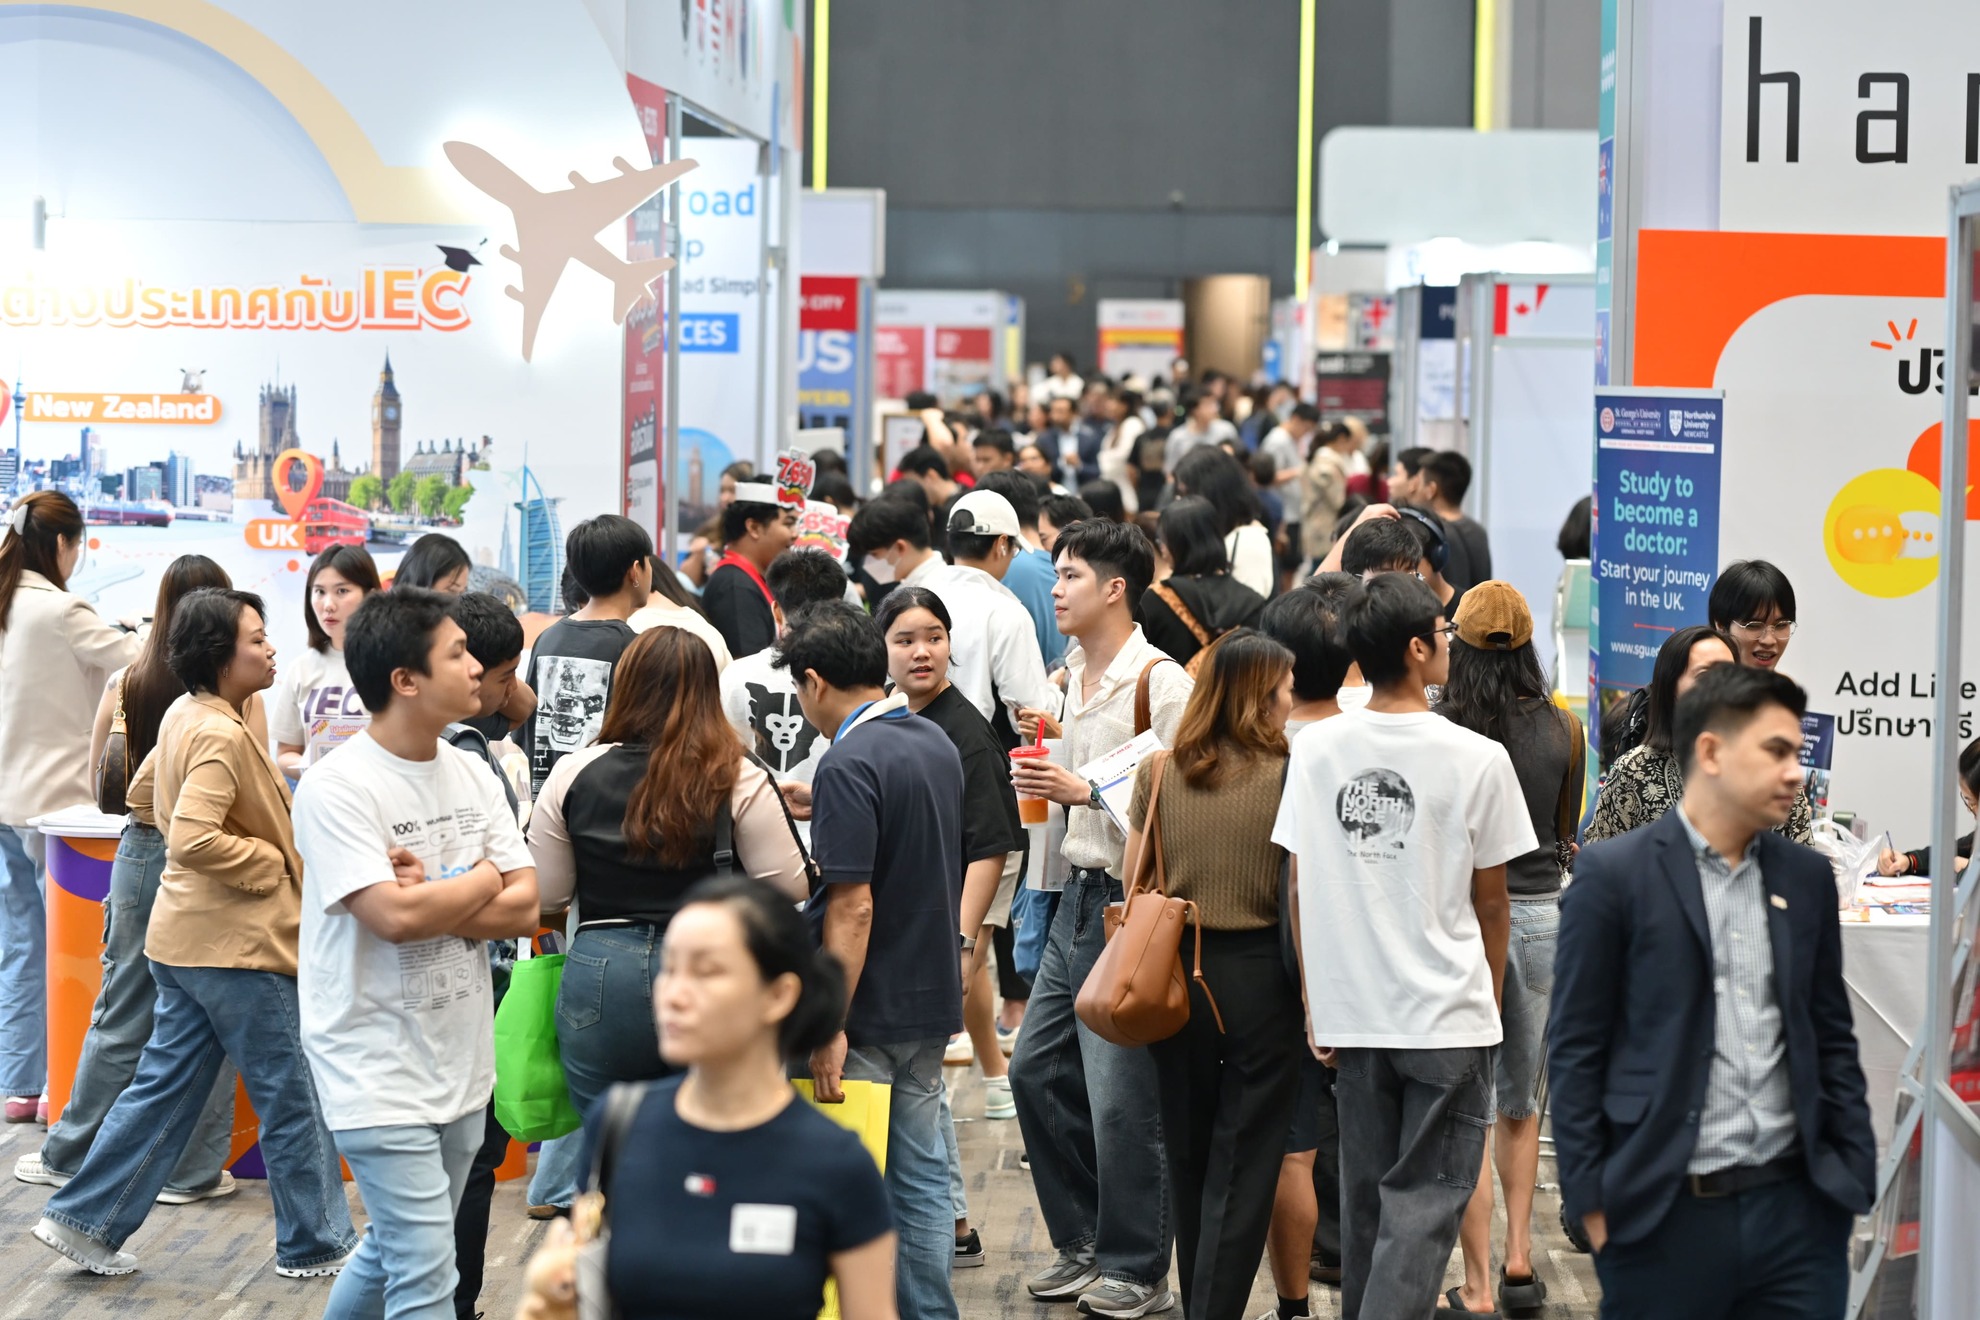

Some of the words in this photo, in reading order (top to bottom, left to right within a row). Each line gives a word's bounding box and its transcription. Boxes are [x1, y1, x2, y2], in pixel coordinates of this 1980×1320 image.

[680, 183, 755, 216] oad
[679, 321, 727, 345] CES
[33, 394, 94, 418] New
[102, 396, 213, 419] Zealand
[1684, 420, 1709, 430] University
[1619, 469, 1672, 502] Study
[1675, 474, 1694, 498] to
[1614, 496, 1684, 526] become
[1688, 508, 1698, 528] a
[258, 523, 300, 548] UK
[1624, 527, 1688, 556] doctor:
[1600, 559, 1630, 580] Start
[1632, 565, 1660, 585] your
[1661, 564, 1710, 592] journey
[1625, 586, 1637, 606] in
[1640, 588, 1659, 608] the
[1663, 591, 1685, 611] UK.
[1610, 641, 1662, 659] www.sgu.ed
[1835, 670, 1900, 697] Add
[1910, 672, 1977, 700] Lie
[1836, 707, 1972, 739] ปรึกษารี
[1345, 780, 1379, 796] THE
[1340, 807, 1386, 824] FACE
[1342, 794, 1404, 813] NORTH
